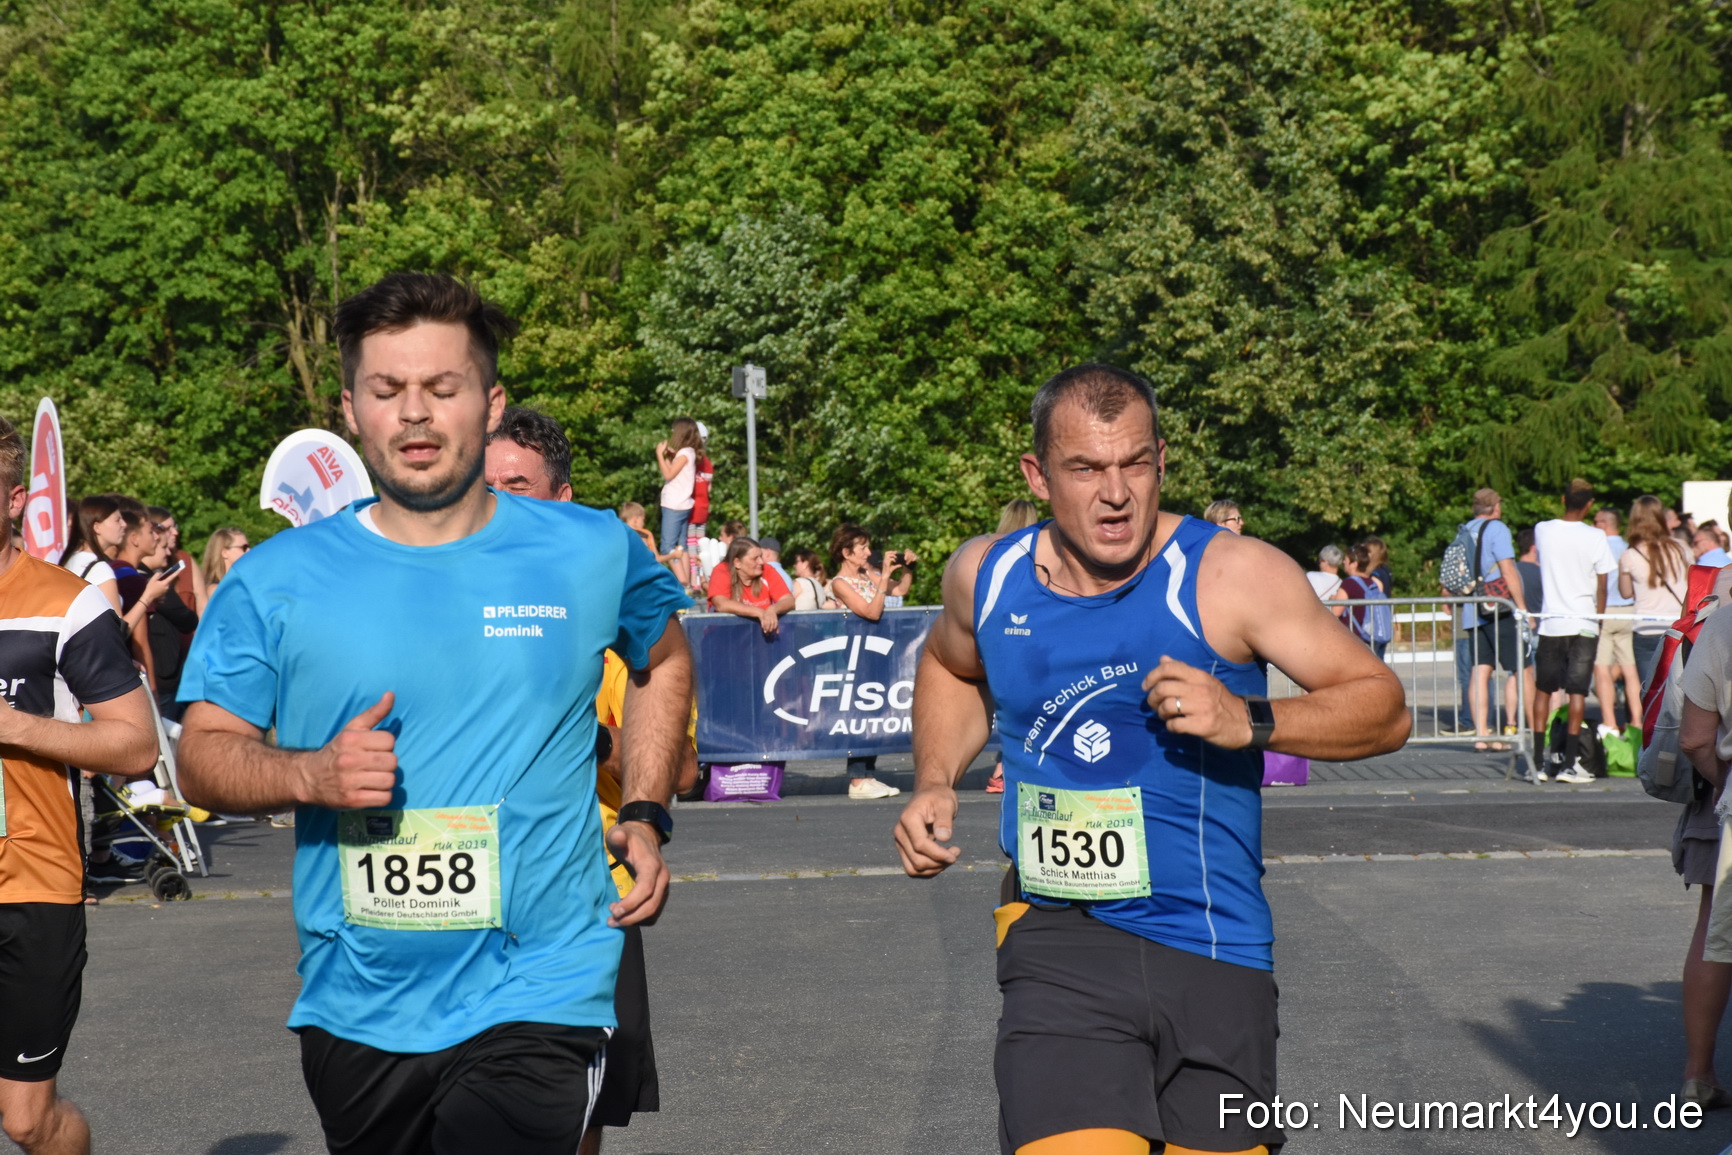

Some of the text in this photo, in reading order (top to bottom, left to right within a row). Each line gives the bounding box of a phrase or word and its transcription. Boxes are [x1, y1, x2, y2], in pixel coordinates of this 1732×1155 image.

[497, 605, 567, 620] PFLEIDERER
[484, 624, 543, 637] Dominik
[1004, 626, 1031, 636] erima
[1023, 662, 1138, 754] Team Schick Bau
[1107, 818, 1133, 828] 2019
[457, 839, 488, 850] 2019
[1031, 825, 1125, 868] 1530
[357, 852, 476, 896] 1858
[1040, 866, 1117, 880] Schick Matthias
[1118, 880, 1141, 888] GmbH
[409, 897, 461, 909] Dominik
[361, 907, 478, 919] Pfleiderer Deutschland GmbH
